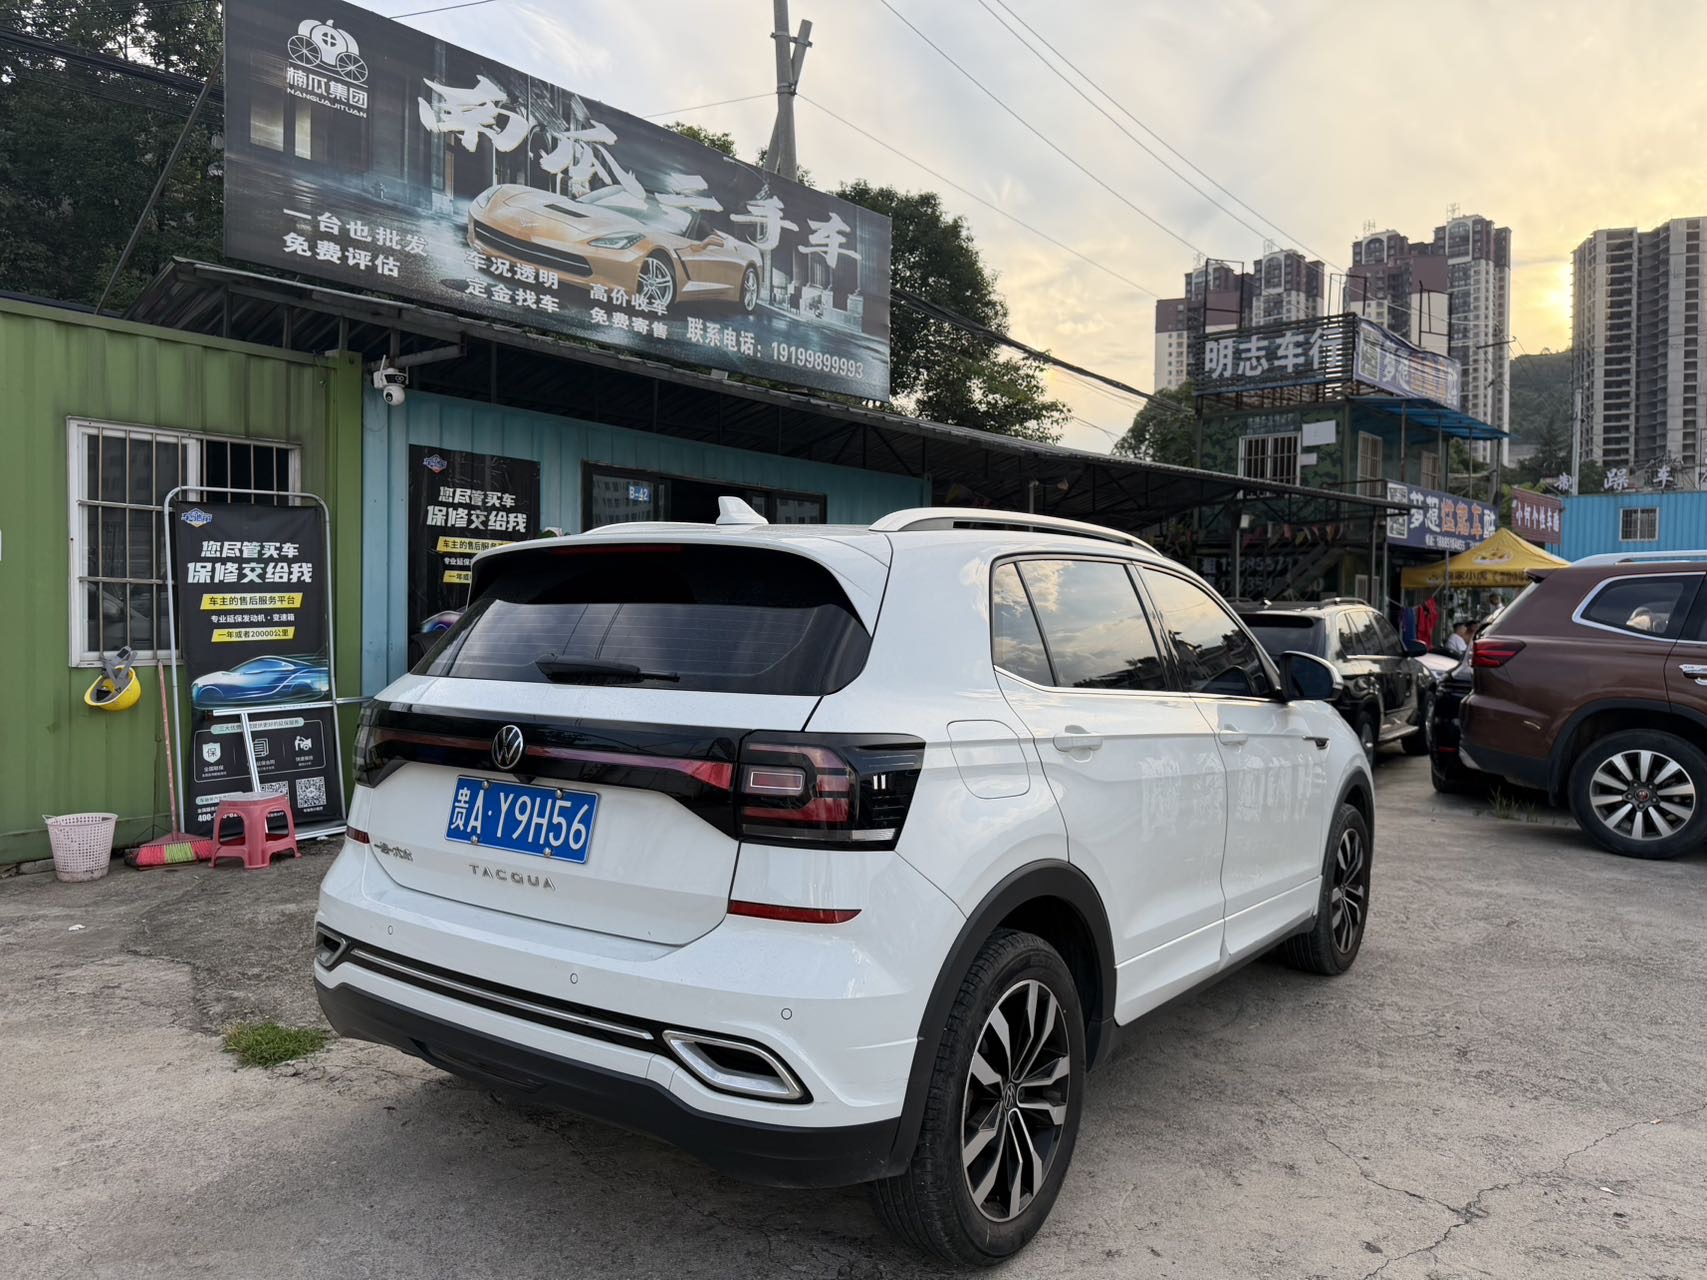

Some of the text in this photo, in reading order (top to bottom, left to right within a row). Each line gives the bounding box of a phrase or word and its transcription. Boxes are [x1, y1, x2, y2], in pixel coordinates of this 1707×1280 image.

[286, 66, 368, 109] 楠瓜集团
[287, 88, 368, 119] NANGUAJITUAN
[282, 208, 427, 257] 一台也批发
[282, 231, 401, 278] 免费评估
[465, 250, 560, 290] 车况透明
[465, 277, 561, 314] 定金找车
[589, 282, 669, 317] 高价收车
[589, 306, 669, 340] 免费寄售
[771, 341, 865, 379] 19199899993
[1204, 326, 1344, 379] 明志车行
[438, 486, 516, 509] 您尽管买车
[629, 485, 649, 501] B-42
[426, 505, 528, 533] 保修交给我
[200, 540, 300, 559] 您尽管买车
[187, 561, 313, 584] 保修交给我
[208, 595, 296, 607] 车主的售后服务平台
[217, 629, 289, 639] 一年或者20000公里
[207, 747, 217, 758] 保
[450, 786, 590, 850] 贵A·Y9H56
[469, 864, 558, 891] TACQUA
